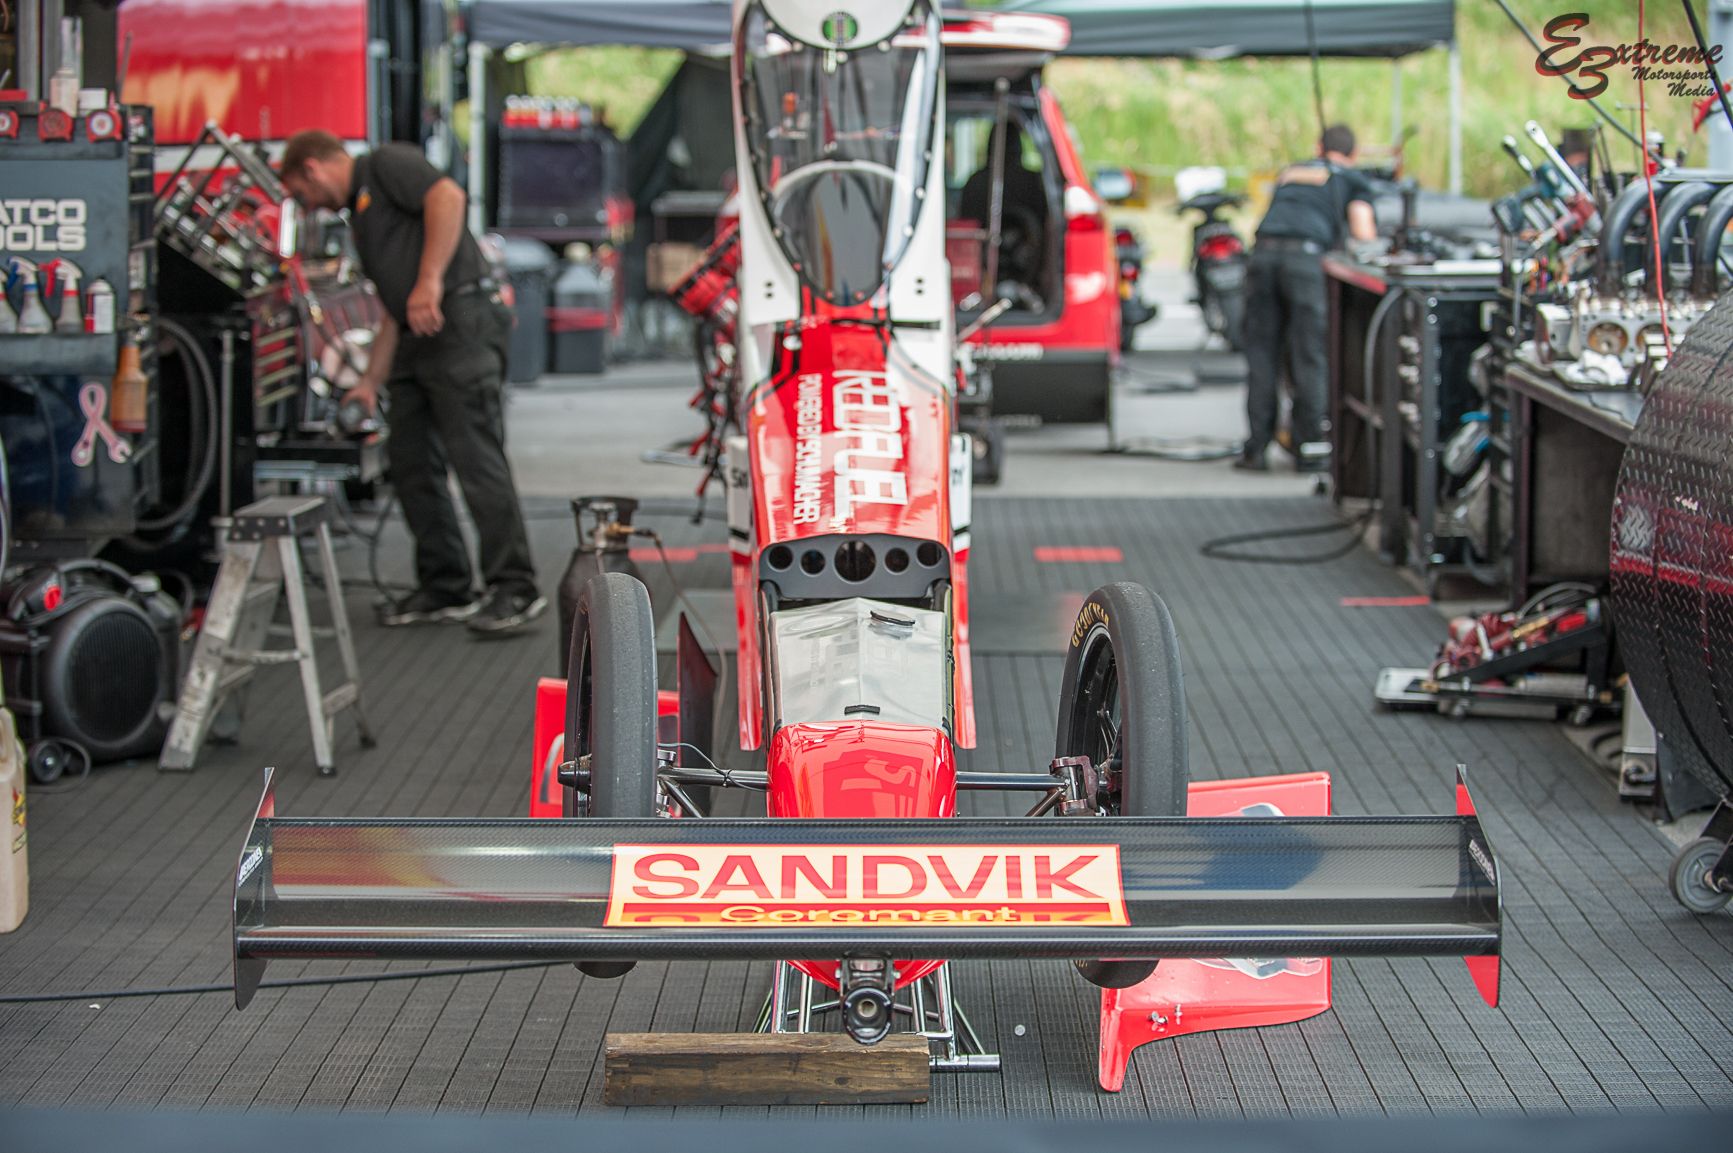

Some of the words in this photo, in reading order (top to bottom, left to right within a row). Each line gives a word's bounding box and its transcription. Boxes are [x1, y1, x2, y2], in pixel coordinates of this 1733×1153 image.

[0, 224, 86, 252] OLS
[797, 373, 823, 426] POWERED
[797, 426, 822, 441] BY
[793, 440, 822, 525] SCHUMACHER
[632, 852, 1106, 900] SANDVIK
[720, 904, 1017, 922] Coromant
